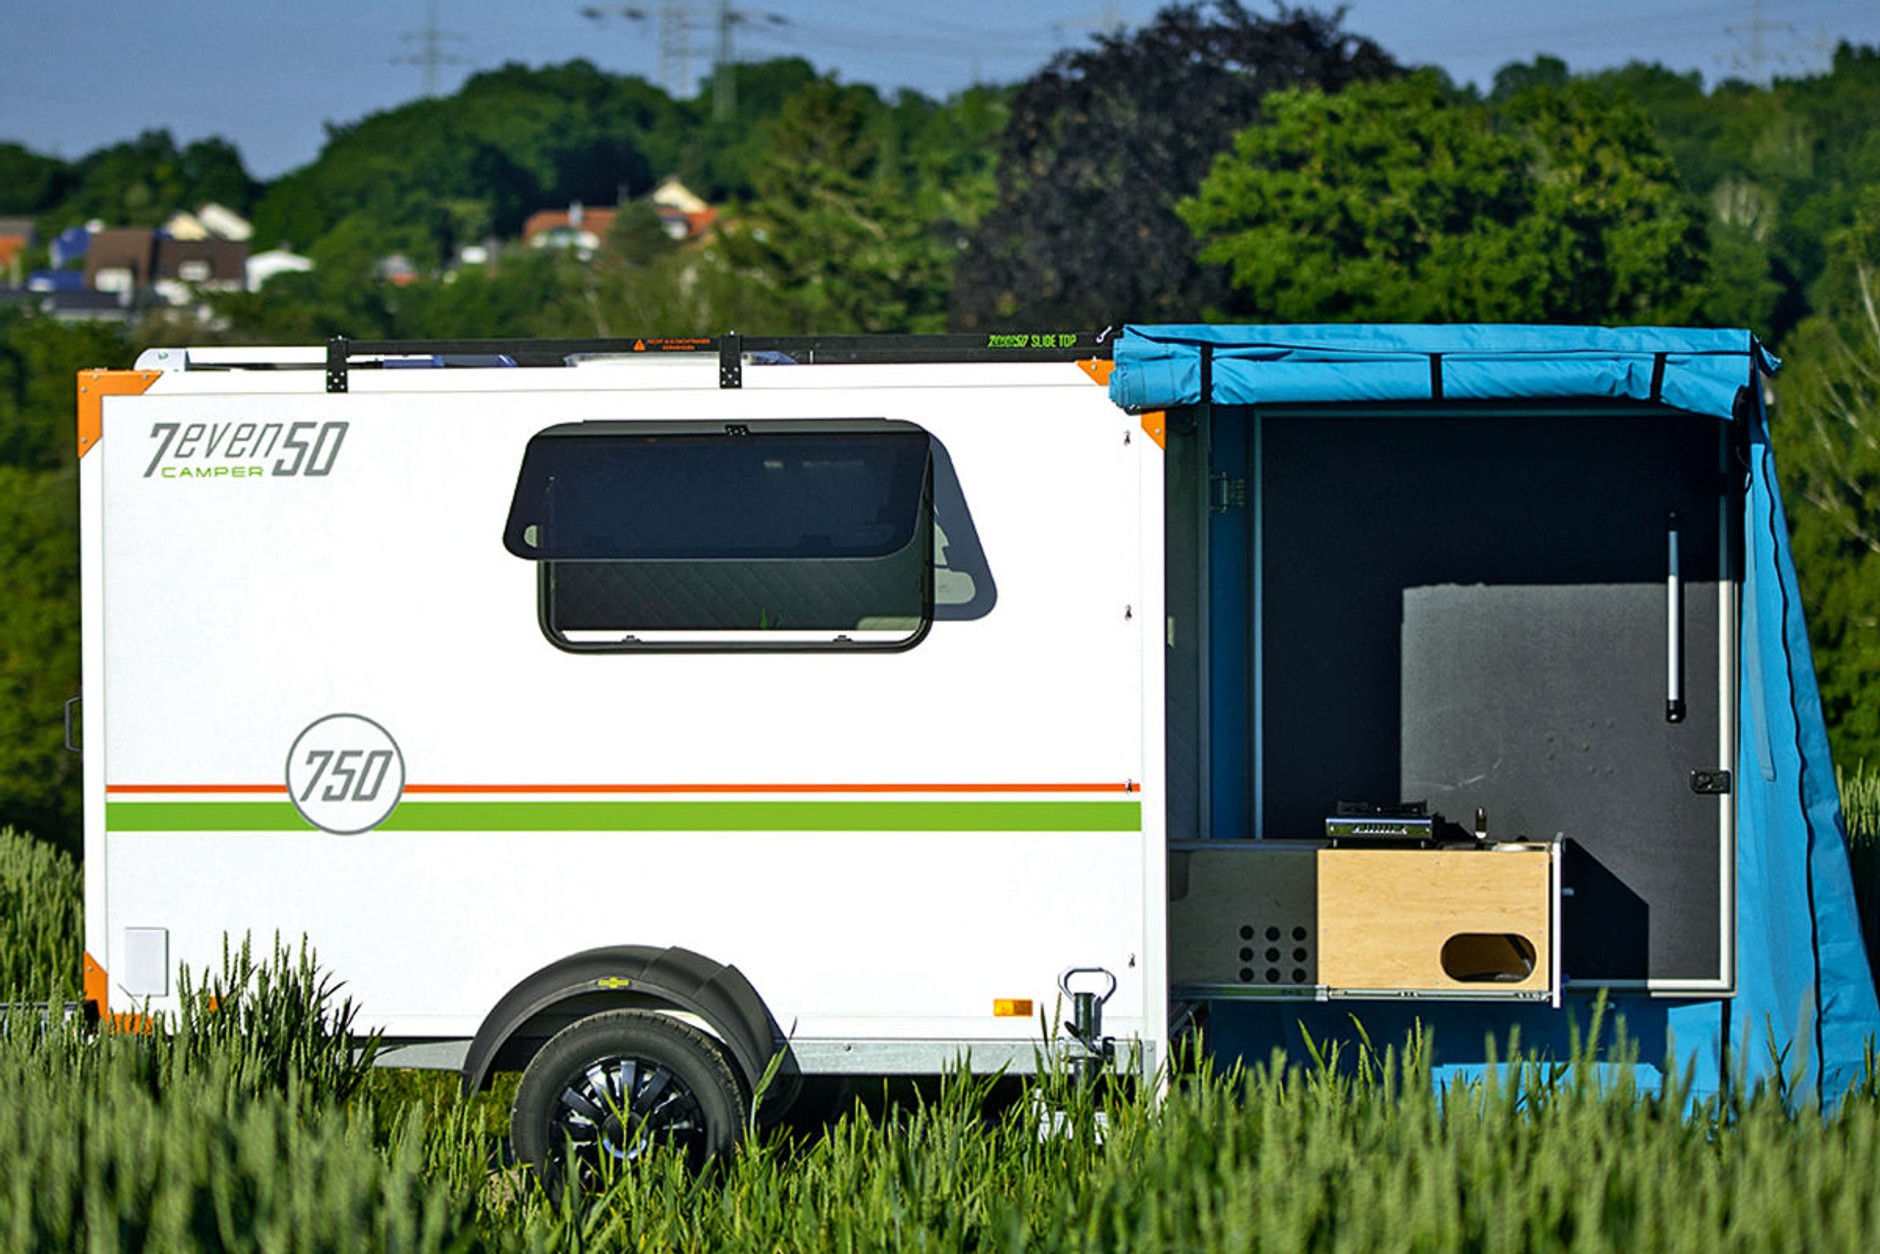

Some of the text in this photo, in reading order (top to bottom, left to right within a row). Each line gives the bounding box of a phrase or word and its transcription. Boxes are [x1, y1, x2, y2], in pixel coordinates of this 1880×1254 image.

[1030, 334, 1057, 348] SLIDE
[1058, 334, 1078, 348] TOP
[160, 466, 264, 478] CAMPER
[299, 750, 394, 802] 750
